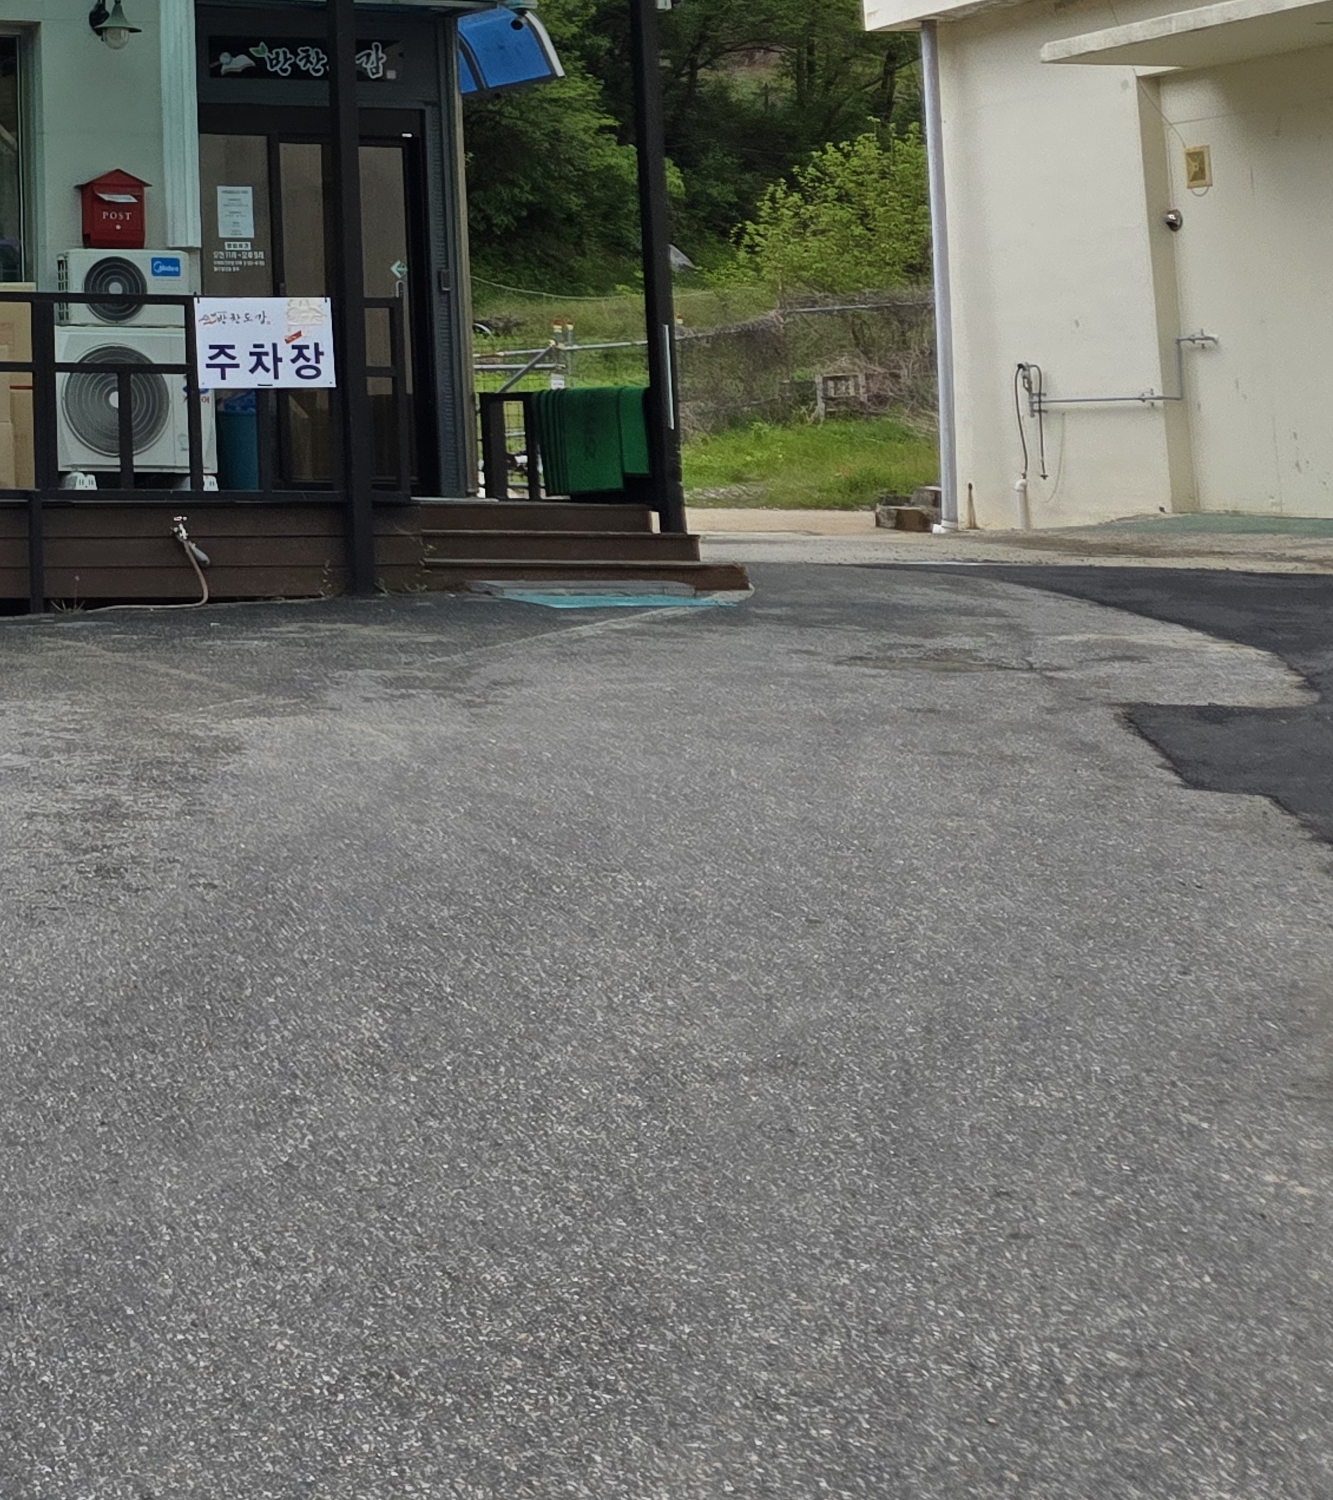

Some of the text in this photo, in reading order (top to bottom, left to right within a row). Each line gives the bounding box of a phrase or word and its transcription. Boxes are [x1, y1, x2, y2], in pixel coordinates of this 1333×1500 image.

[266, 42, 386, 79] 반찬감
[102, 211, 132, 220] POST
[205, 342, 324, 380] 주차장
